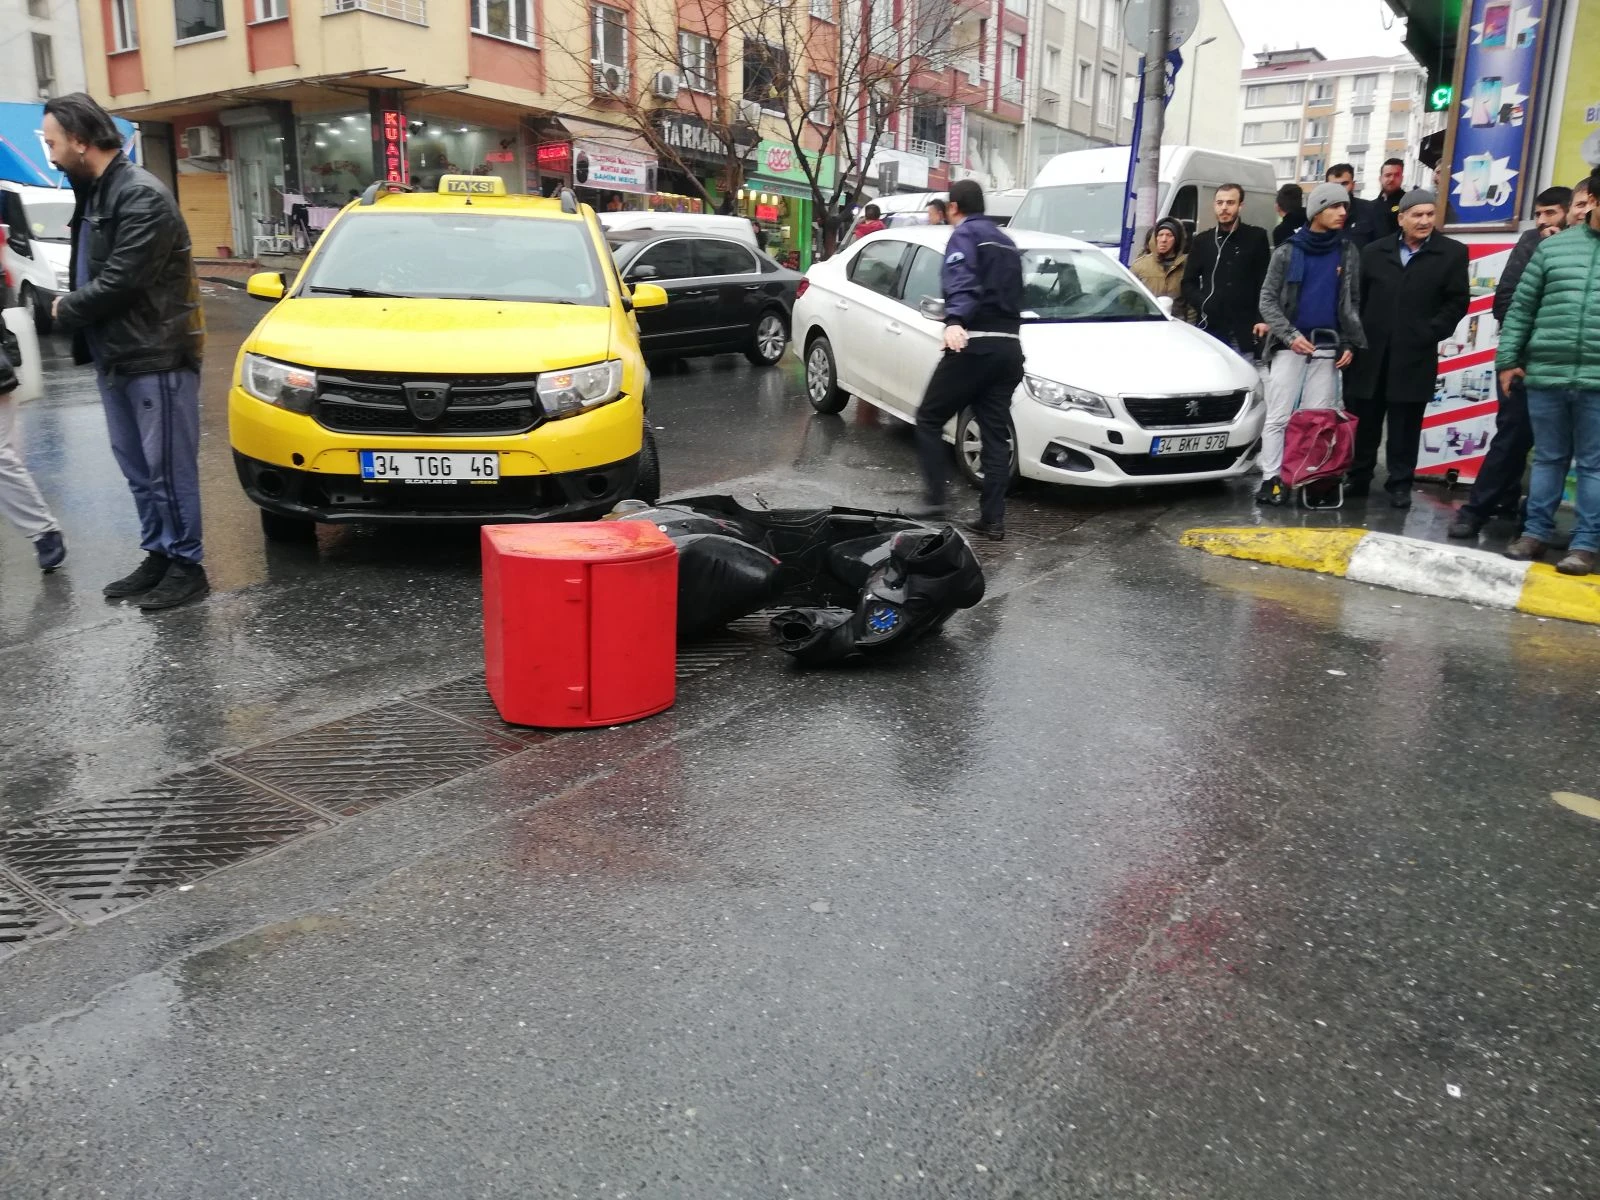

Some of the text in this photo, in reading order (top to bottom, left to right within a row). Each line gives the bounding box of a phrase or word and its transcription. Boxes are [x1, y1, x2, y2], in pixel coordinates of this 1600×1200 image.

[1159, 438, 1172, 453] 34
[1178, 437, 1200, 452] BKH
[1205, 435, 1226, 450] 978
[375, 455, 400, 476] 34
[414, 455, 452, 477] TGG
[470, 456, 494, 477] 46
